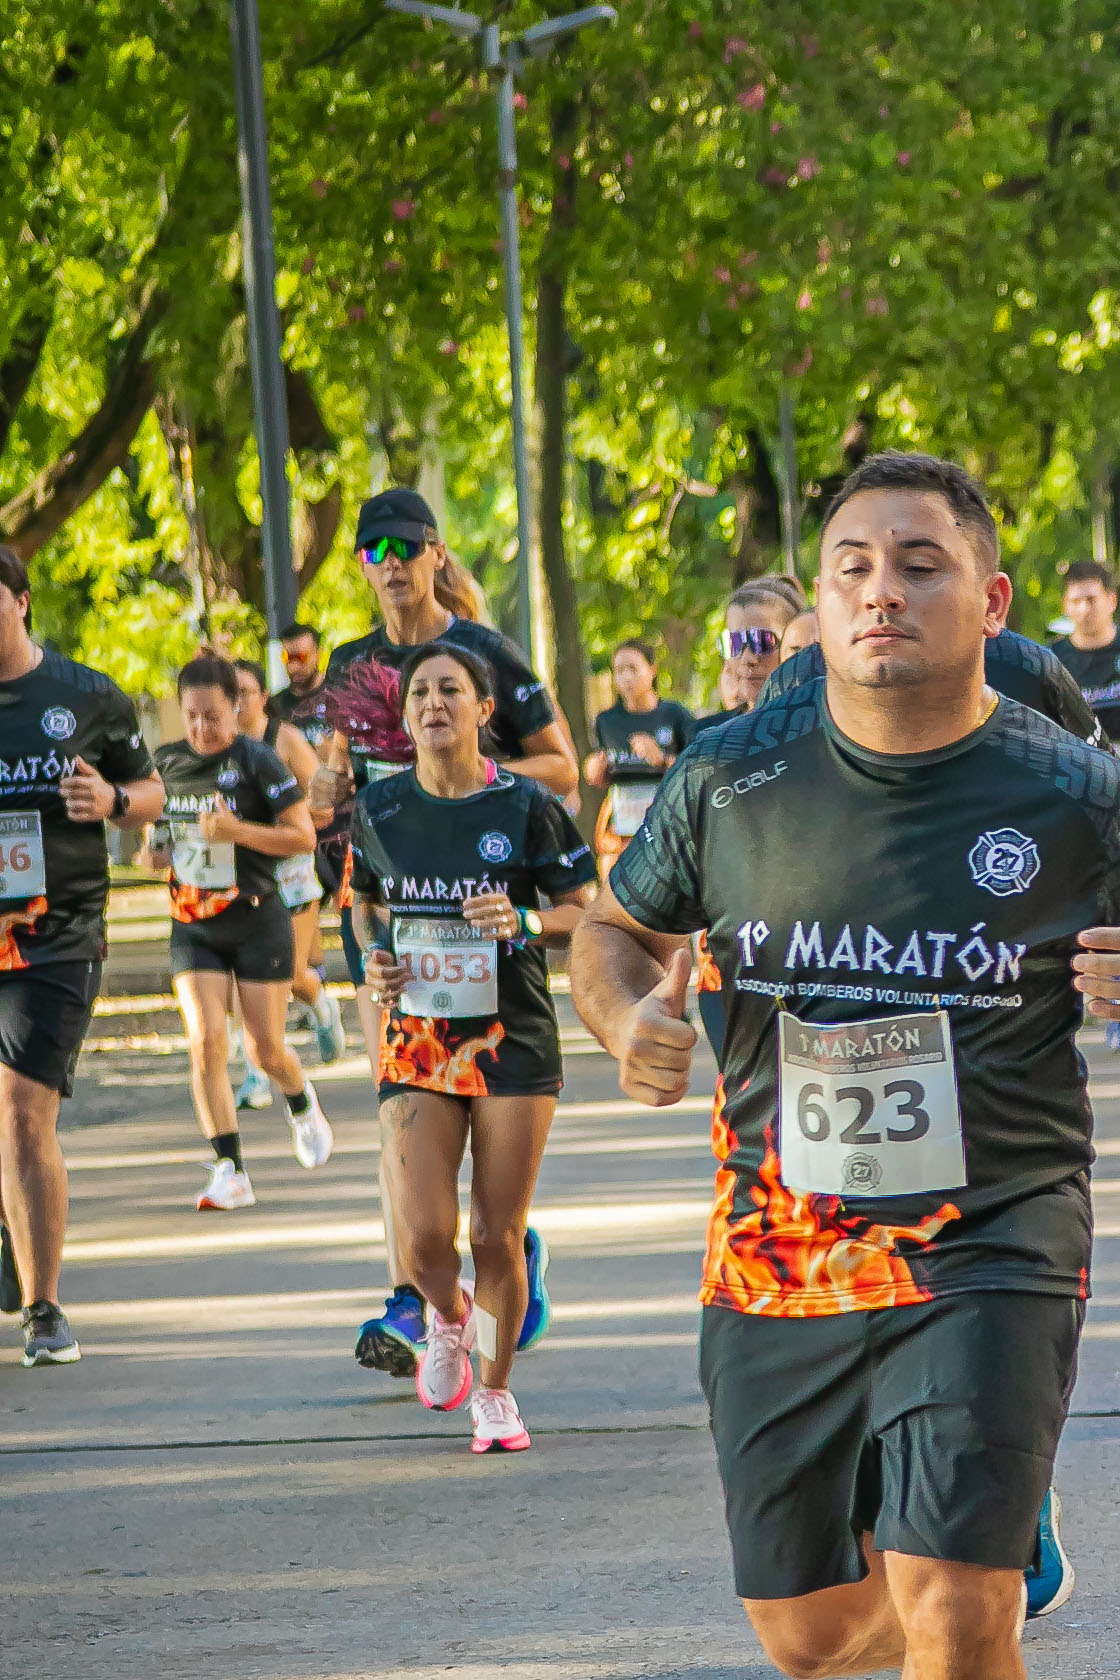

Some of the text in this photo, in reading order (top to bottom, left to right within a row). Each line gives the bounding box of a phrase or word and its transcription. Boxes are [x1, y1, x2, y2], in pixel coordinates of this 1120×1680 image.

[737, 920, 1027, 984] 1º MARATÓN
[798, 983, 873, 1001] BOMBEROS
[875, 989, 970, 1006] VOLUNTARIOS
[812, 1024, 921, 1058] MARATÓN
[798, 1079, 931, 1144] 623
